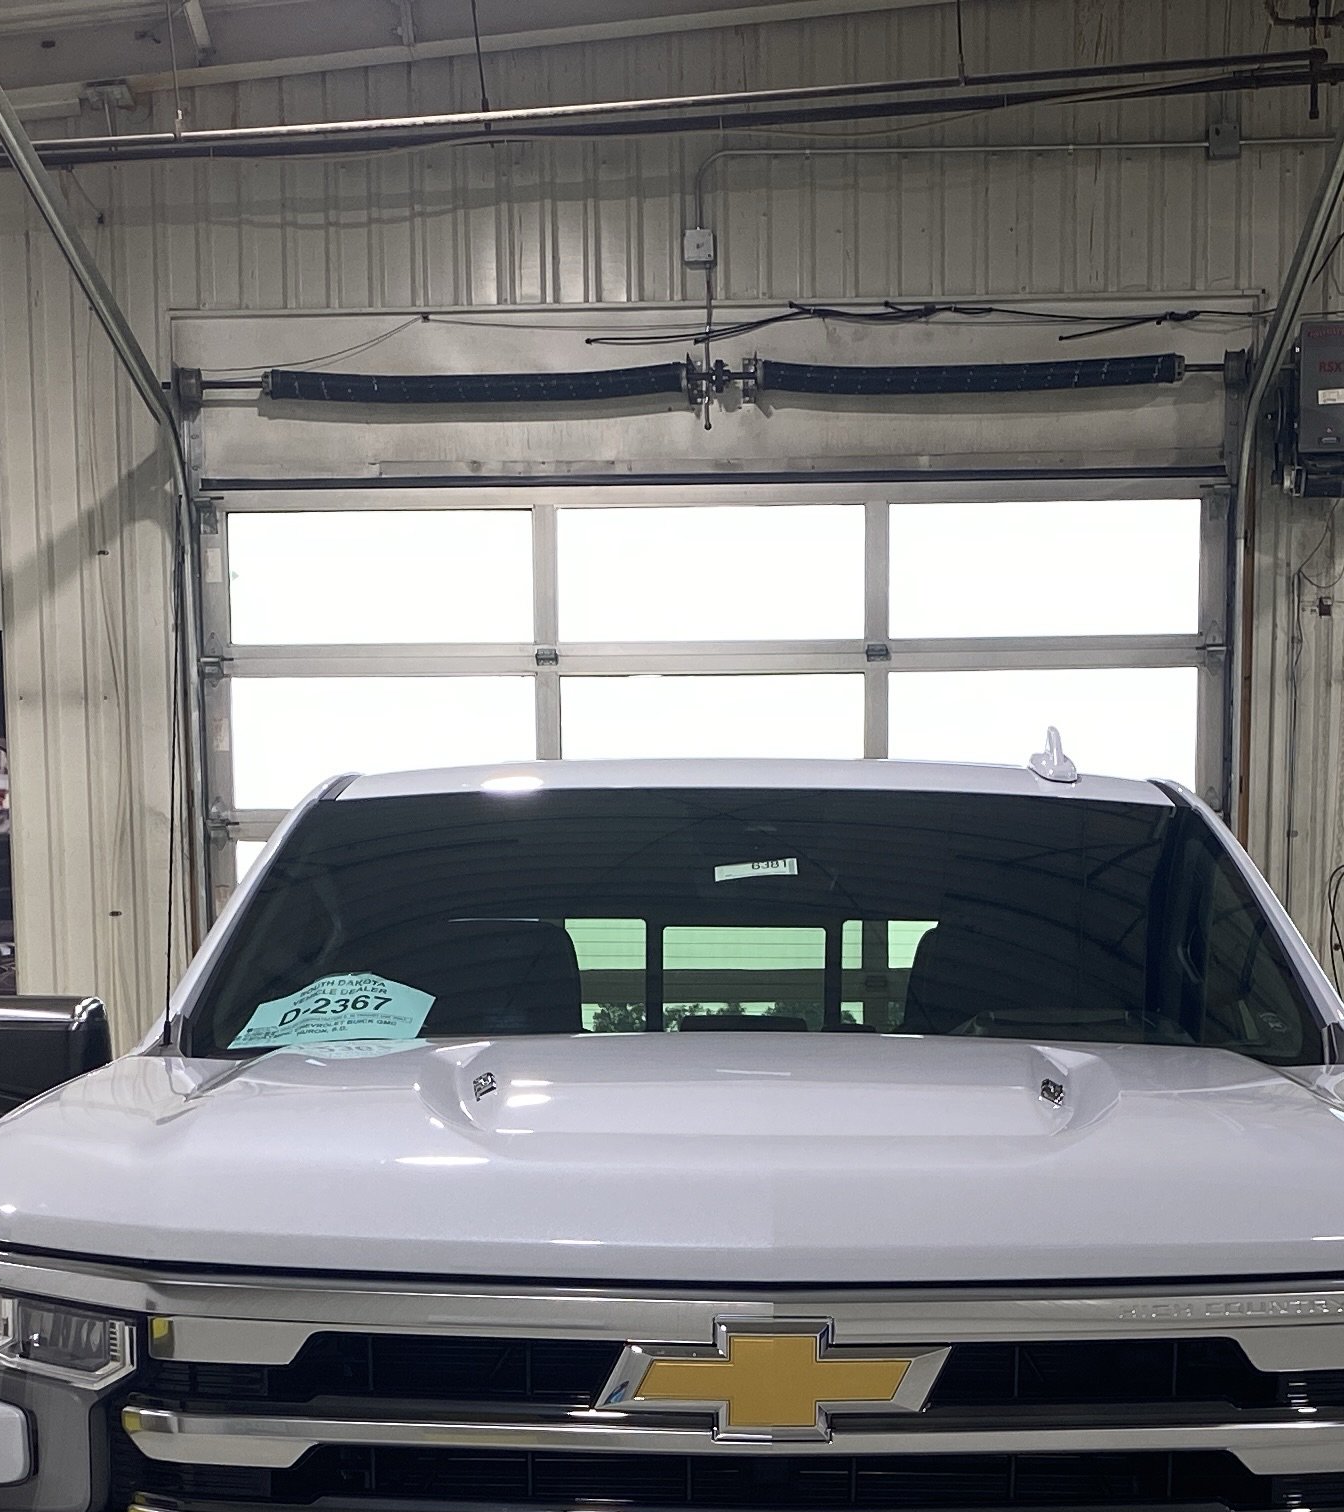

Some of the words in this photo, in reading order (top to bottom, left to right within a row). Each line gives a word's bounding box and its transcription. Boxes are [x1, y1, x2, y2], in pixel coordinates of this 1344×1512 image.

[299, 979, 336, 998] SOUTH
[337, 978, 387, 988] DAKOTA
[339, 986, 388, 996] DEALER
[278, 994, 393, 1027] D-2367
